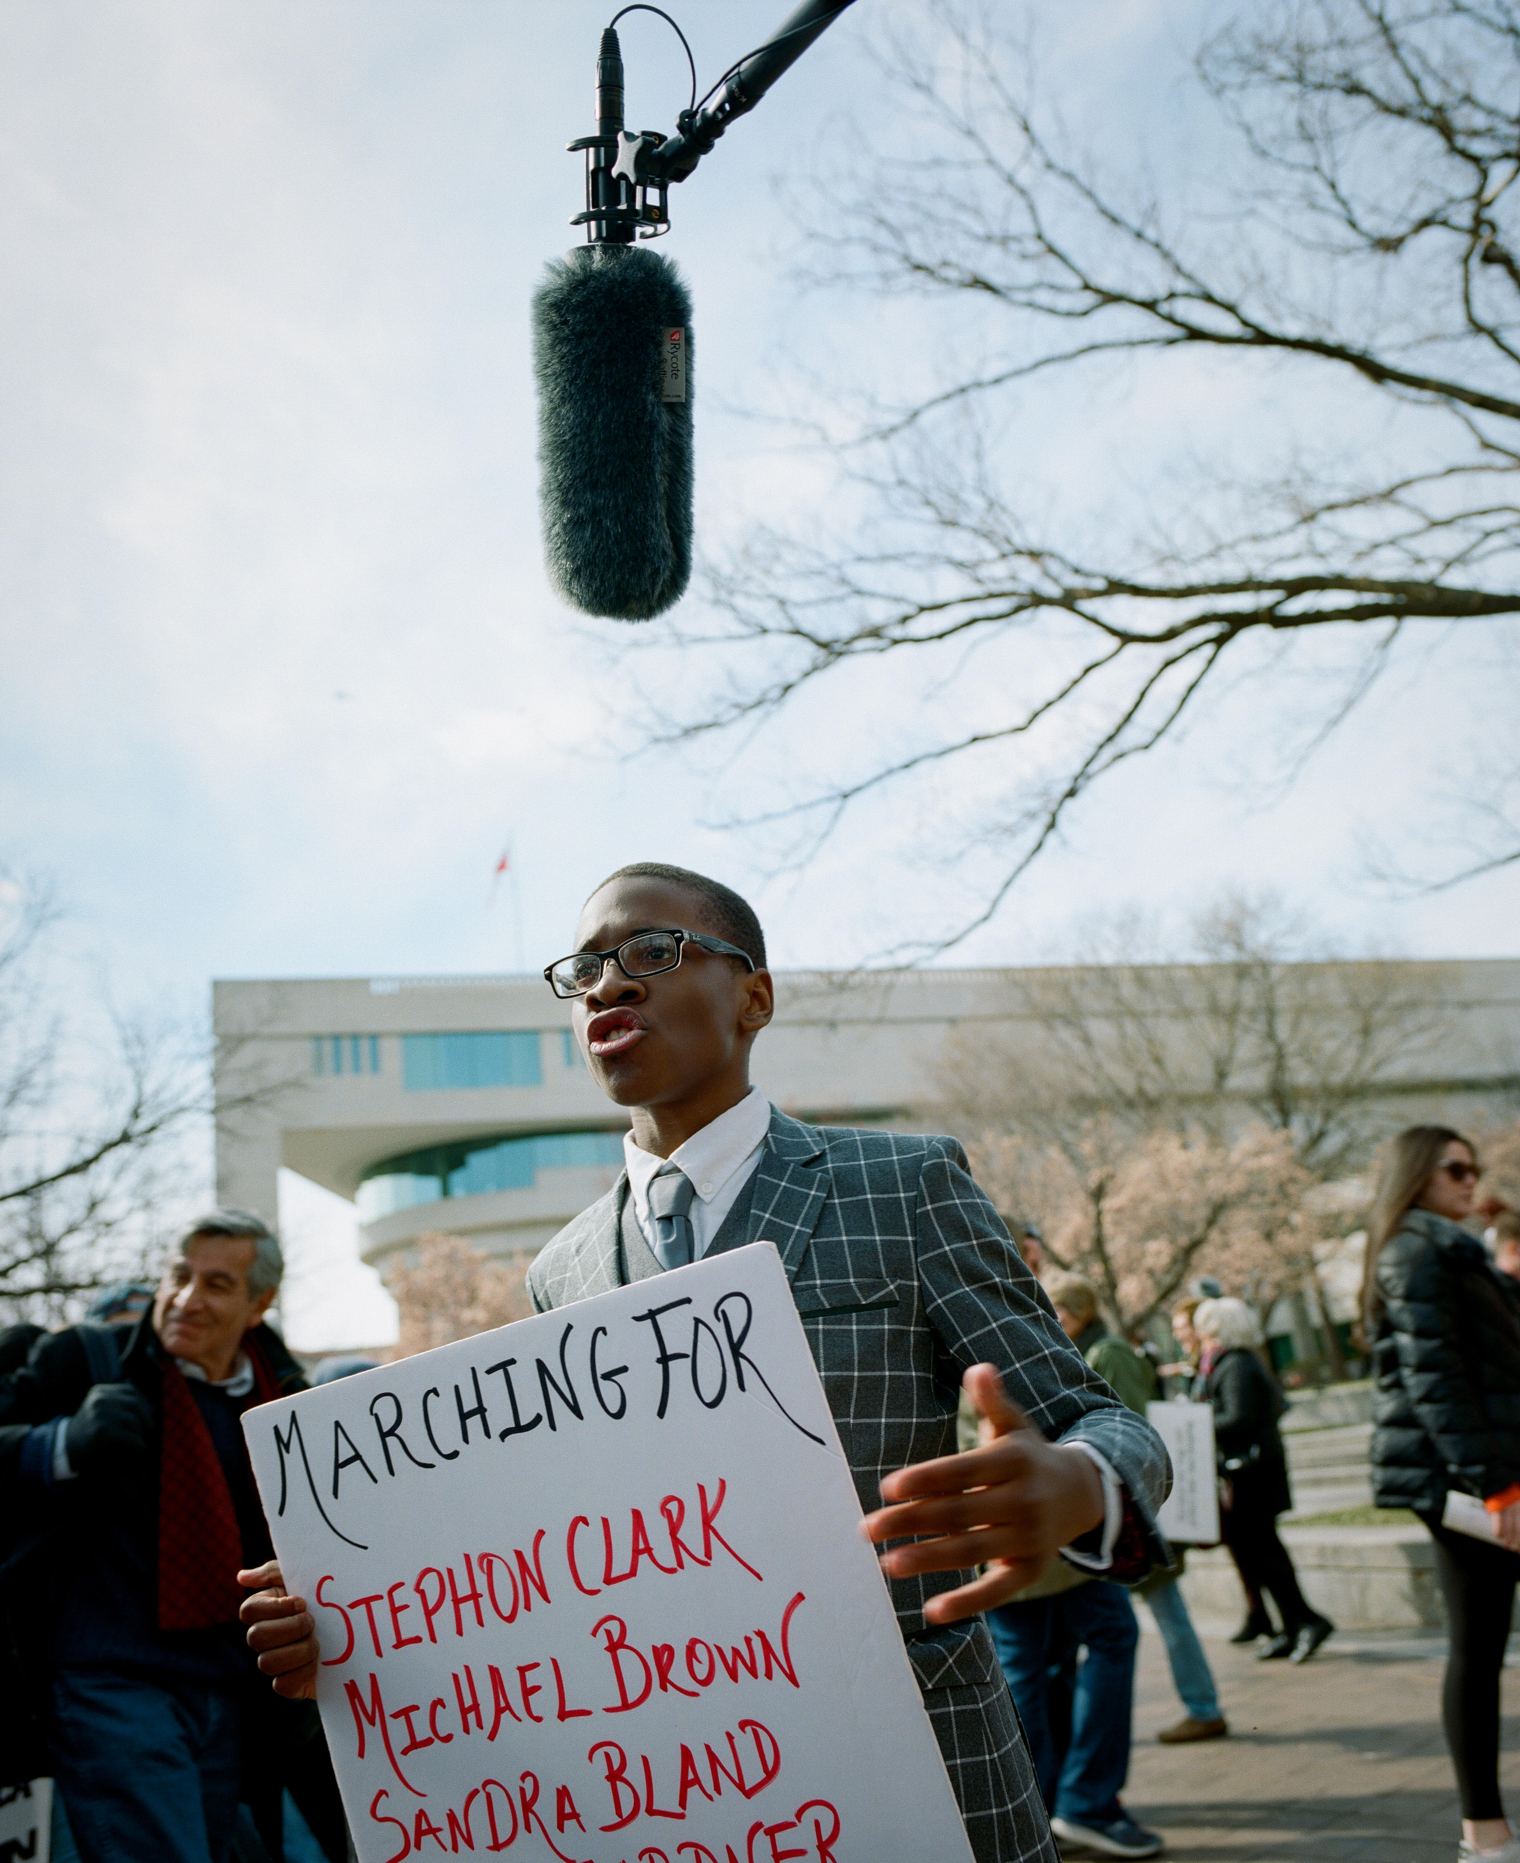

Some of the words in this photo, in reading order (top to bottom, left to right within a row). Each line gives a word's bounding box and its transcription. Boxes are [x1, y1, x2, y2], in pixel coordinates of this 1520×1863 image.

[666, 342, 682, 380] Rycote
[273, 1322, 630, 1550] MARCHING
[632, 1291, 826, 1446] FOR
[317, 1529, 552, 1667] STEPHON
[566, 1477, 763, 1597] CLARK
[344, 1656, 593, 1798] MICHAEL
[592, 1592, 806, 1713] BROWN
[369, 1770, 588, 1863] SANDRA
[589, 1719, 781, 1833] BLAND
